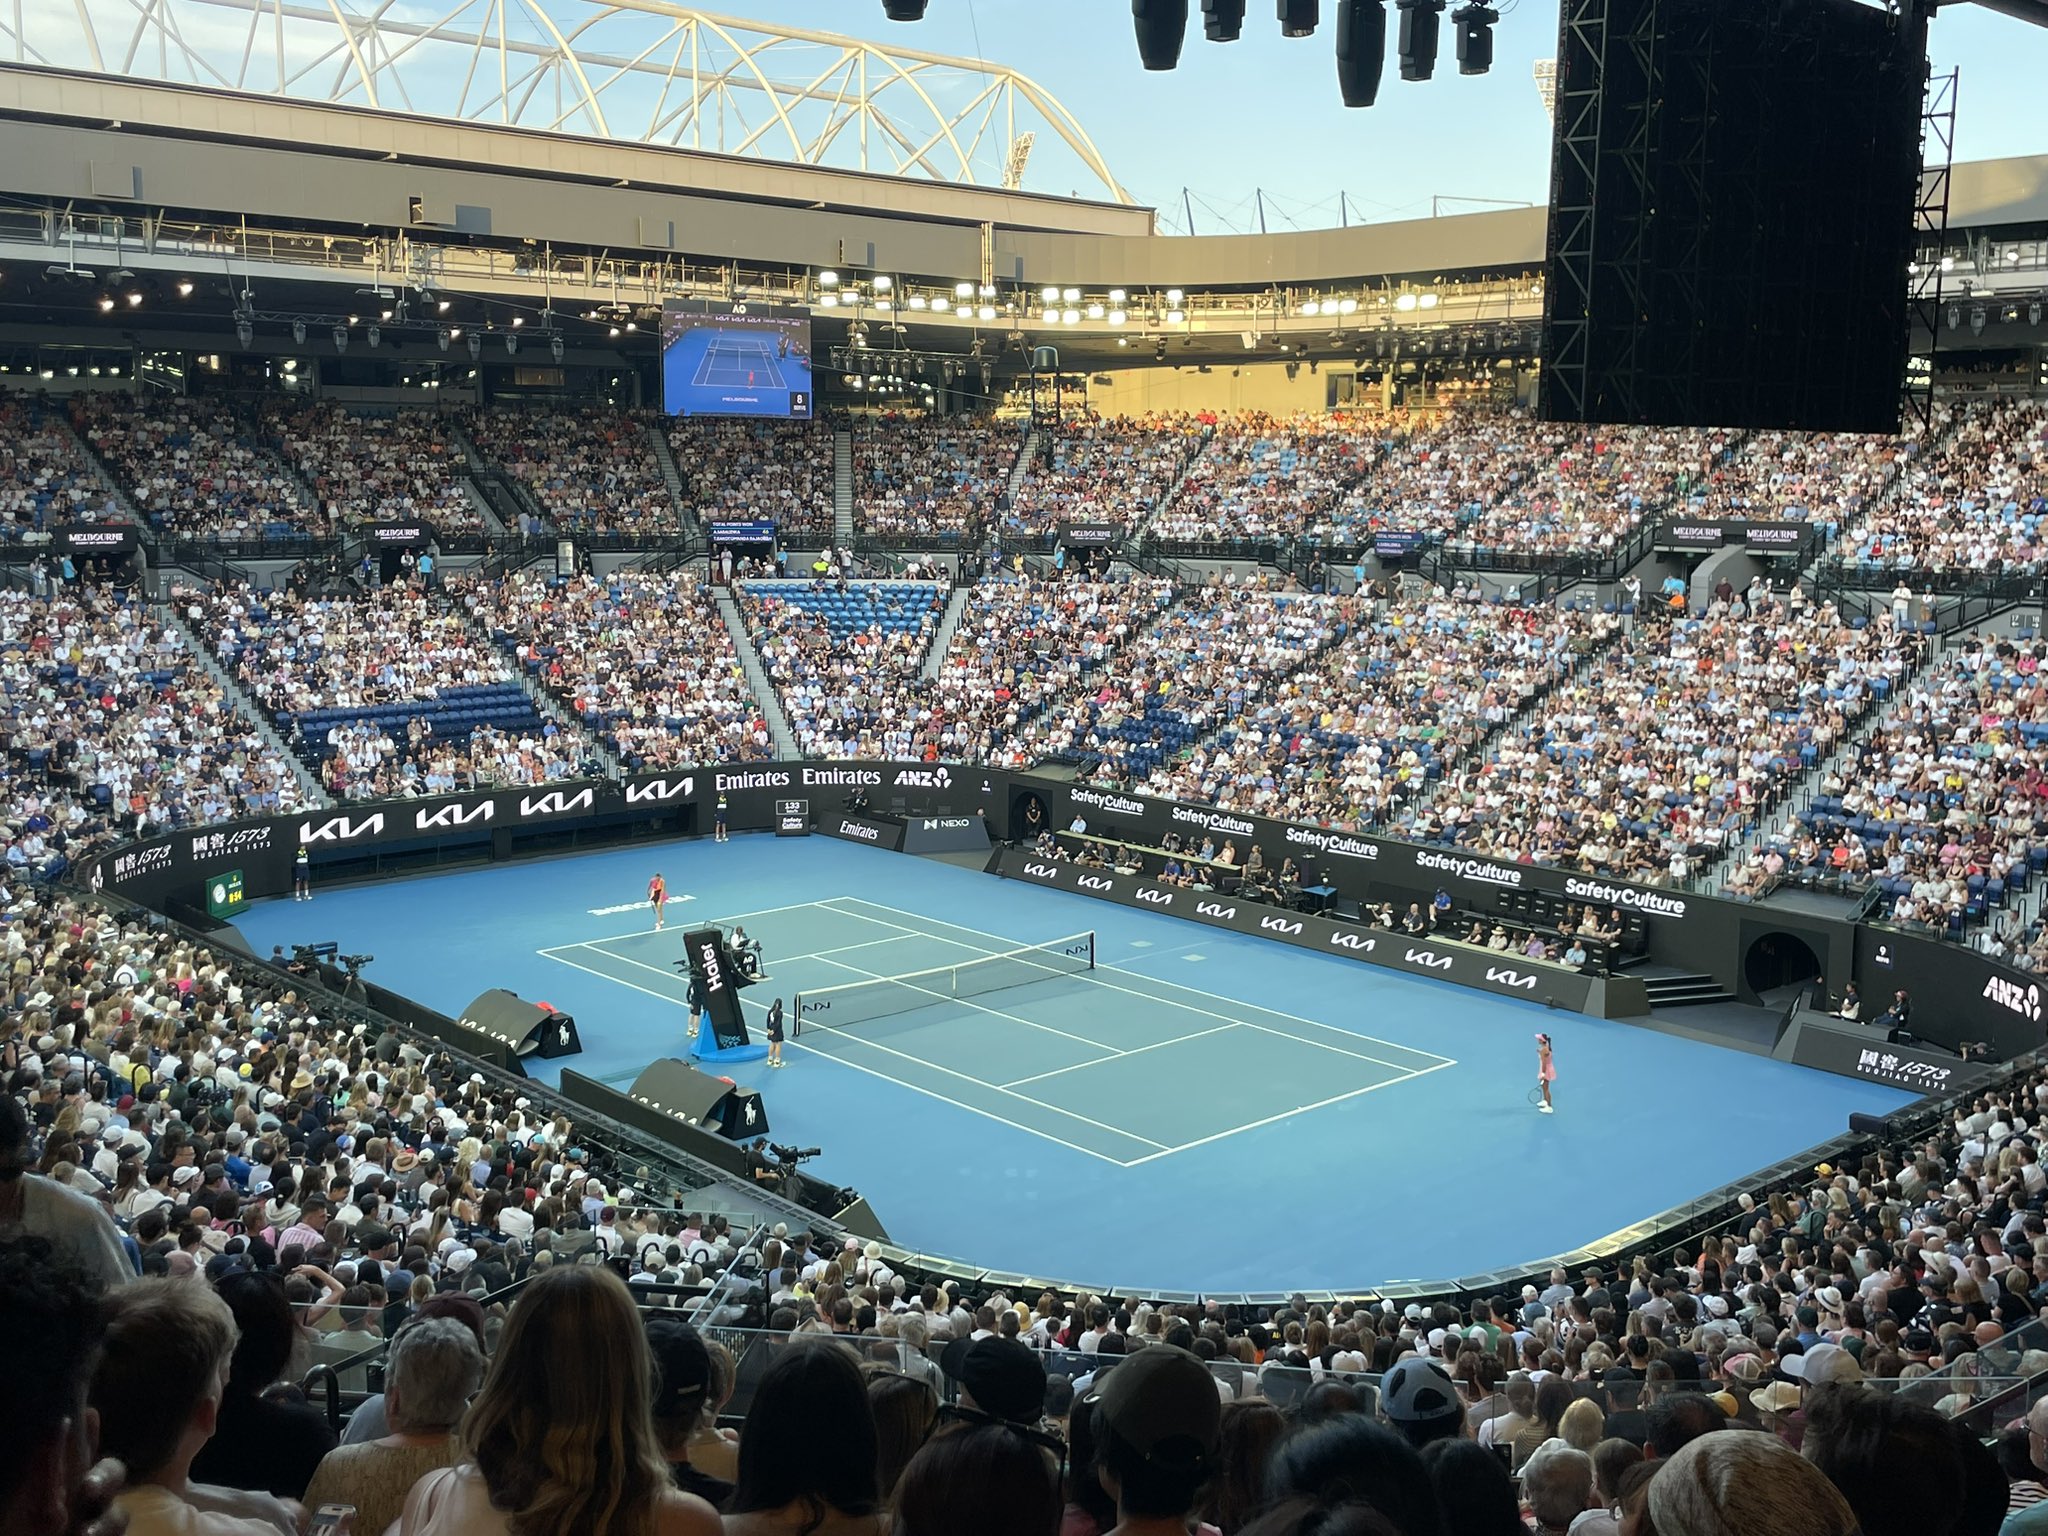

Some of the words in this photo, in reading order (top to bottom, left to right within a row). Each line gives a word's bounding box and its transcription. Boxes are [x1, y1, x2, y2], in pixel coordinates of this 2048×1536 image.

[733, 305, 746, 314] AO
[796, 394, 803, 404] 8
[68, 532, 124, 542] MELBOURNE
[374, 528, 421, 537] MELBOURNE
[1069, 530, 1112, 538] MELBOURNE
[1672, 526, 1723, 538] MELBOURNE
[1746, 528, 1799, 540] MELBOURNE
[715, 771, 790, 791] Emirates
[803, 768, 880, 784] Emirates
[893, 771, 932, 787] ANZ
[626, 777, 693, 803] KIA
[520, 788, 593, 816] KIA
[784, 801, 801, 810] 133
[1071, 788, 1144, 814] SafetyCulture
[416, 800, 494, 829] KIA
[941, 819, 969, 827] NEXO
[1172, 806, 1254, 835] SafetyCulture
[300, 813, 384, 843] KIA
[840, 821, 878, 839] Emirates
[247, 839, 270, 850] 1573
[1286, 827, 1379, 858] SafetyCulture
[1024, 863, 1056, 878] KIA
[1416, 851, 1521, 885] SafetyCulture
[1078, 875, 1112, 890] KIA
[1136, 888, 1172, 904] KIA
[1565, 878, 1685, 915] SafetyCulture
[1197, 902, 1235, 919] KIA
[1261, 917, 1302, 934] KIA
[1331, 932, 1375, 951] KIA
[1405, 949, 1452, 969] KIA
[1879, 945, 1887, 956] 9
[701, 944, 723, 991] Haier
[1486, 968, 1536, 988] KIA
[1982, 976, 2024, 1013] ANZ
